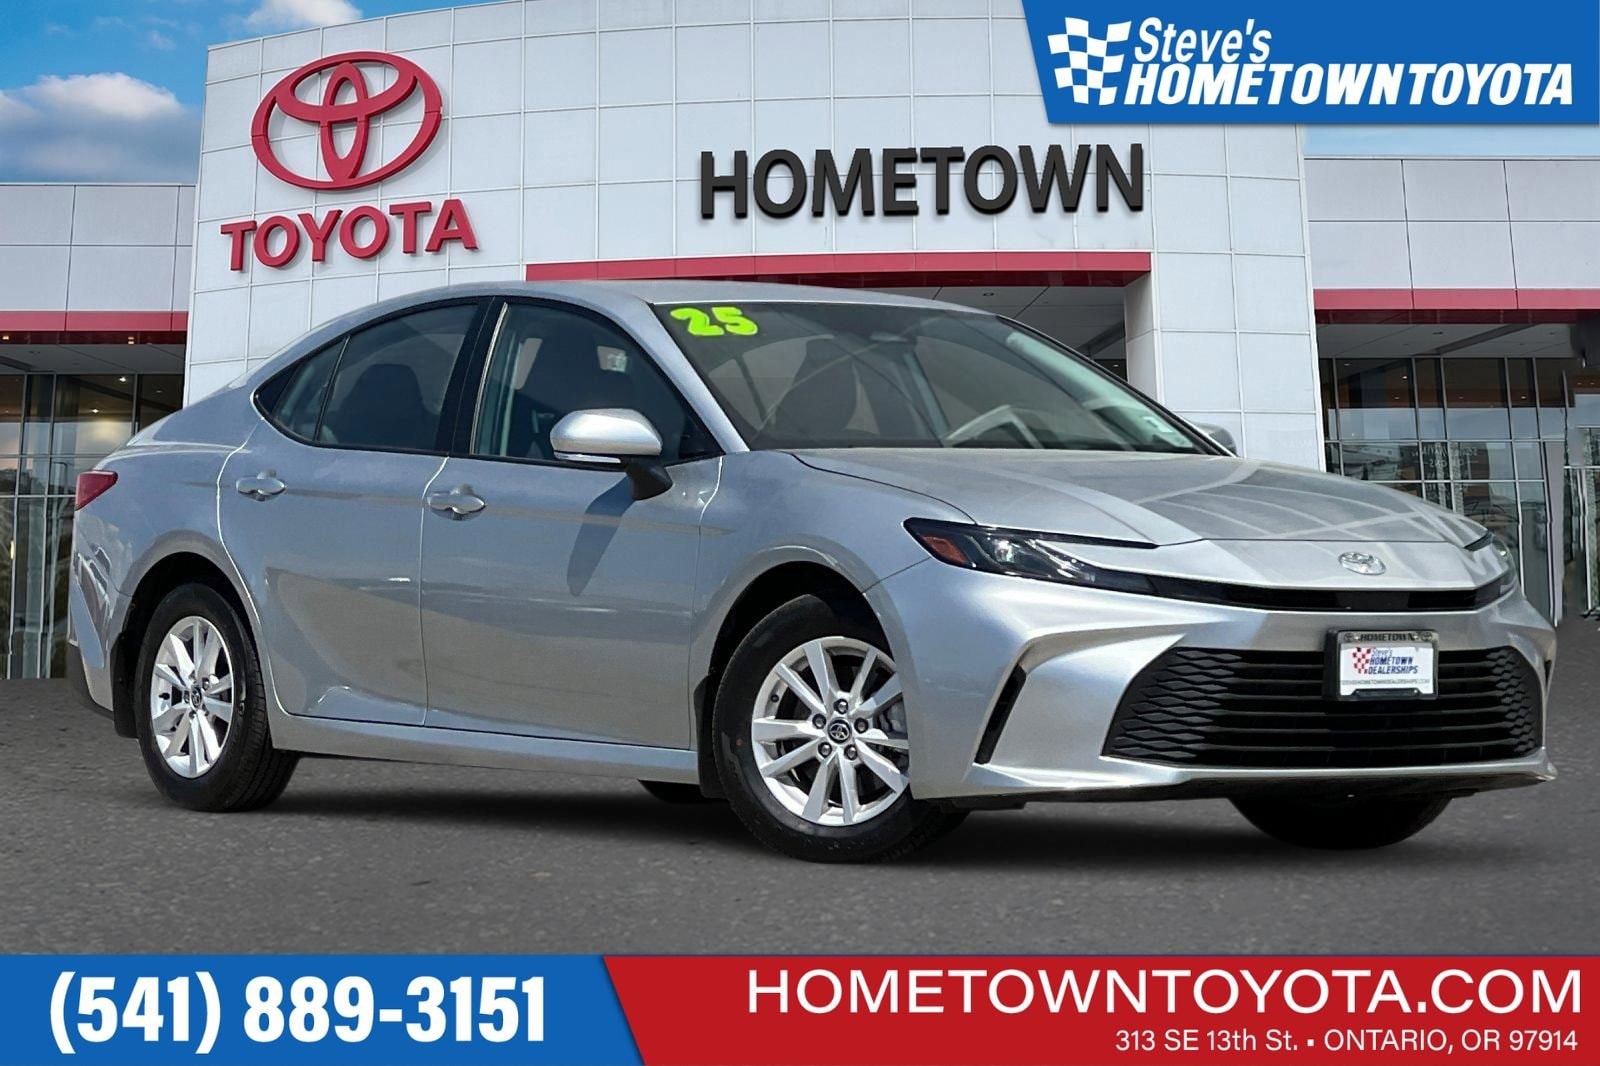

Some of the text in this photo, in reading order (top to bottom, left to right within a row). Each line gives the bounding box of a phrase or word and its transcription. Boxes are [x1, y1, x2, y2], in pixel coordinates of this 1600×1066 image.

[700, 144, 1144, 220] HOMETOWN
[220, 198, 479, 271] TOYOTA
[670, 306, 759, 337] 25
[1359, 632, 1415, 642] HOMETOWN
[1368, 665, 1419, 675] DEALERSHIPS
[1369, 656, 1413, 666] HOMETOWN
